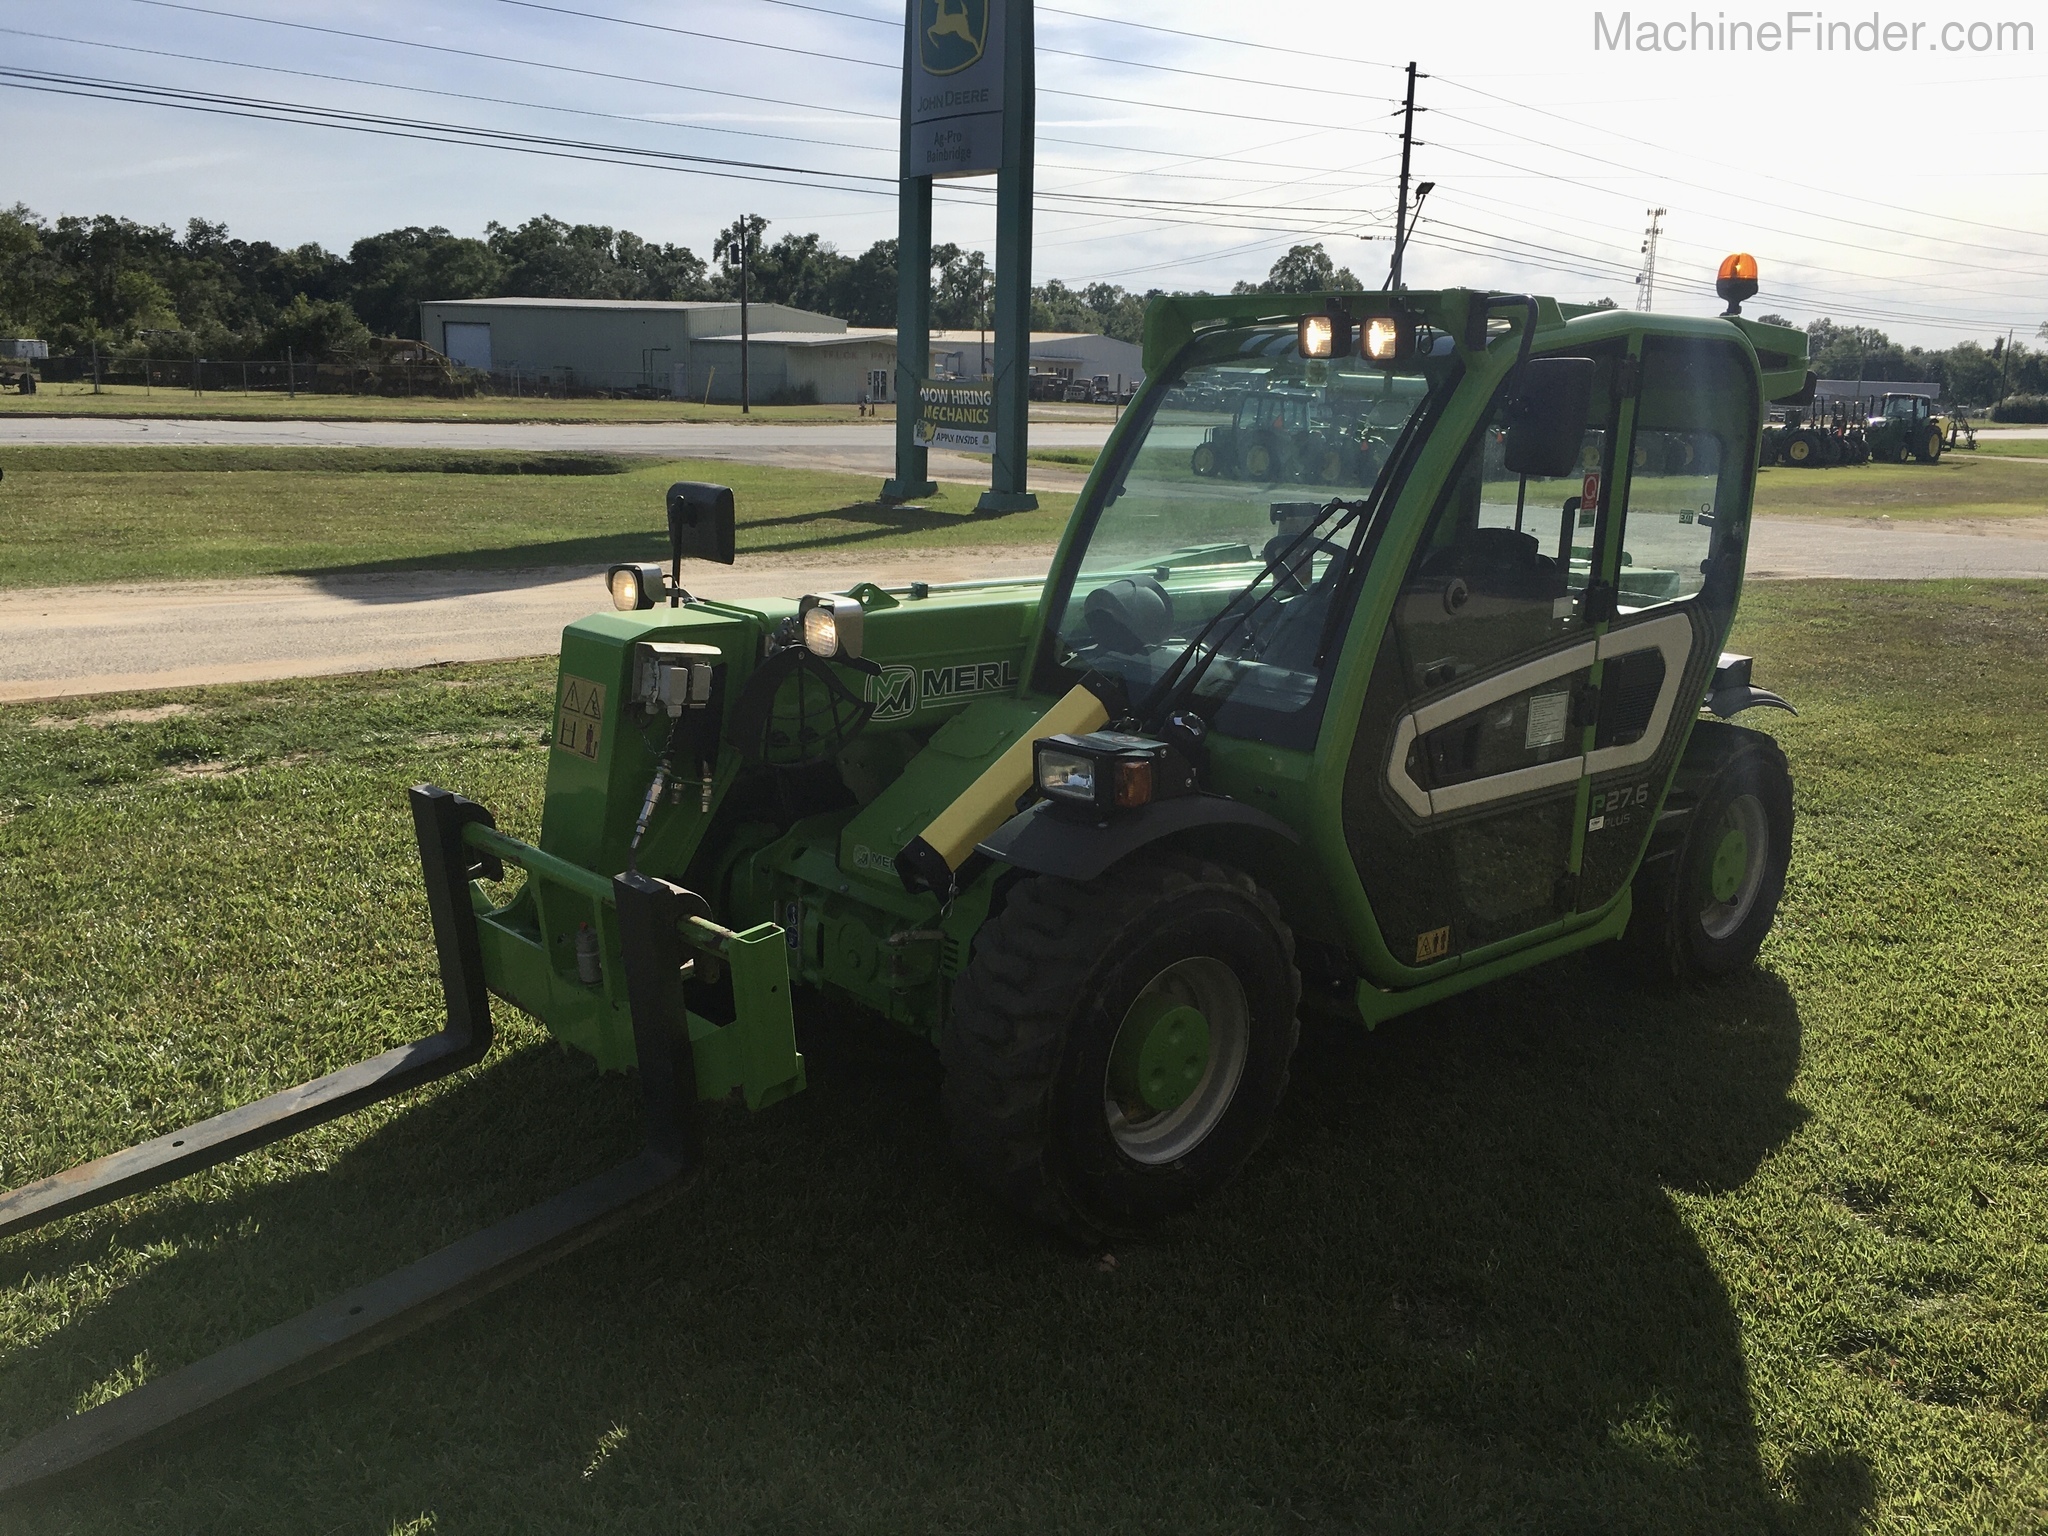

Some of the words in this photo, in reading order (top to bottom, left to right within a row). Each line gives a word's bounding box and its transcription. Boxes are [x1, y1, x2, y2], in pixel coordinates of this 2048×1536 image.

[917, 95, 944, 112] JOHN
[945, 88, 989, 106] DEERE
[934, 130, 962, 148] Ag-Pro
[926, 146, 971, 163] Bainbridge
[920, 387, 948, 403] NOW
[951, 389, 992, 406] HIRING
[924, 405, 989, 424] MECHANICS
[936, 433, 954, 443] APPLY
[955, 435, 978, 445] INSIDE
[1591, 782, 1649, 817] P27.6
[1603, 813, 1631, 829] PLUS
